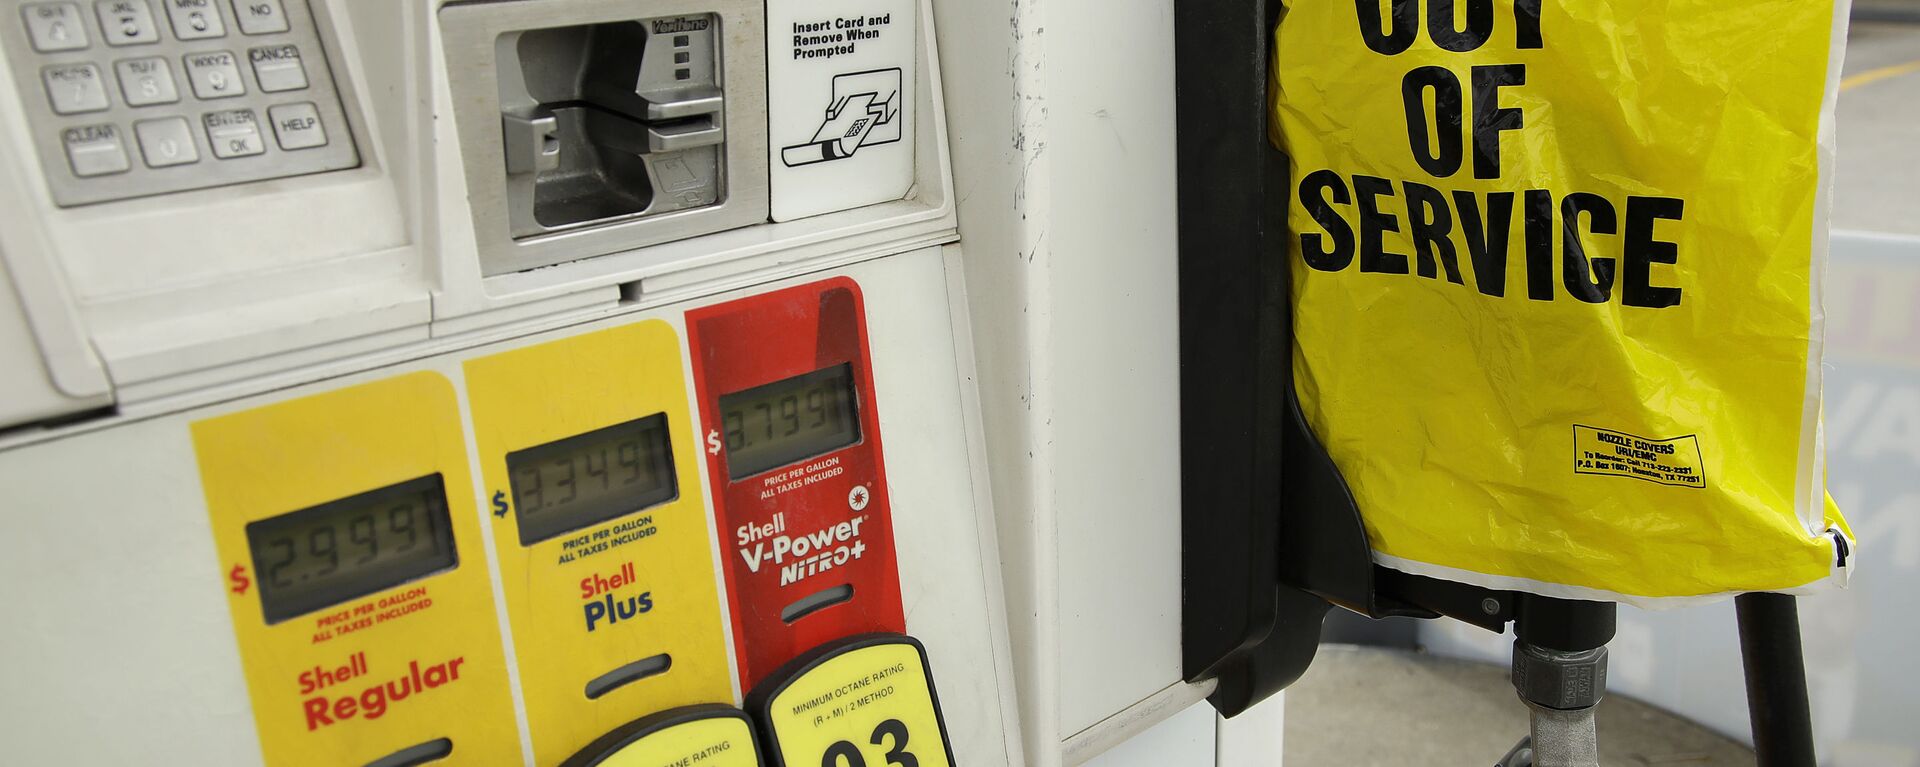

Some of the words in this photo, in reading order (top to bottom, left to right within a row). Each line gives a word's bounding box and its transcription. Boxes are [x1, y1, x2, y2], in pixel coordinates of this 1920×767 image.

[250, 4, 271, 16] NO
[793, 20, 831, 33] Insert
[835, 16, 864, 29] Card
[868, 13, 890, 26] and
[793, 33, 843, 46] Remove
[846, 29, 879, 41] When
[793, 42, 855, 60] Prompted
[65, 126, 114, 143] CLEAR
[281, 117, 315, 131] HELP
[1401, 64, 1526, 179] OF
[229, 139, 248, 153] OK
[1299, 169, 1684, 308] SERVICE
[707, 429, 722, 455] $
[1584, 451, 1593, 459] To
[1597, 432, 1632, 447] NOZZLE
[1634, 440, 1674, 454] COVERS
[761, 489, 775, 500] ALL
[777, 480, 803, 494] TAXES
[804, 466, 843, 485] INCLUDED
[764, 473, 787, 487] PRICE
[789, 468, 804, 479] PER
[806, 457, 840, 473] GALLON
[492, 490, 509, 518] $
[562, 535, 590, 550] PRICE
[593, 529, 610, 541] PER
[612, 515, 652, 534] GALLON
[736, 511, 785, 545] Shell
[269, 504, 417, 589] 2.999
[558, 553, 575, 565] ALL
[578, 541, 609, 558] TAXES
[610, 526, 657, 548] INCLUDED
[740, 516, 864, 573] V-Power
[229, 564, 250, 595] $
[580, 562, 636, 599] Shell
[312, 631, 333, 644] ALL
[335, 617, 373, 635] TAXES
[376, 598, 433, 623] INCLUDED
[317, 611, 350, 628] PRICE
[353, 603, 375, 616] PER
[378, 587, 426, 608] GALLON
[584, 591, 653, 632] Plus
[298, 651, 368, 695] Shell
[303, 656, 464, 732] Regular
[792, 692, 833, 716] MINIMUM
[835, 676, 871, 698] OCTANE
[873, 663, 904, 682] RATING
[850, 702, 856, 711] 2
[857, 685, 894, 707] METHOD
[692, 741, 730, 763] RATING
